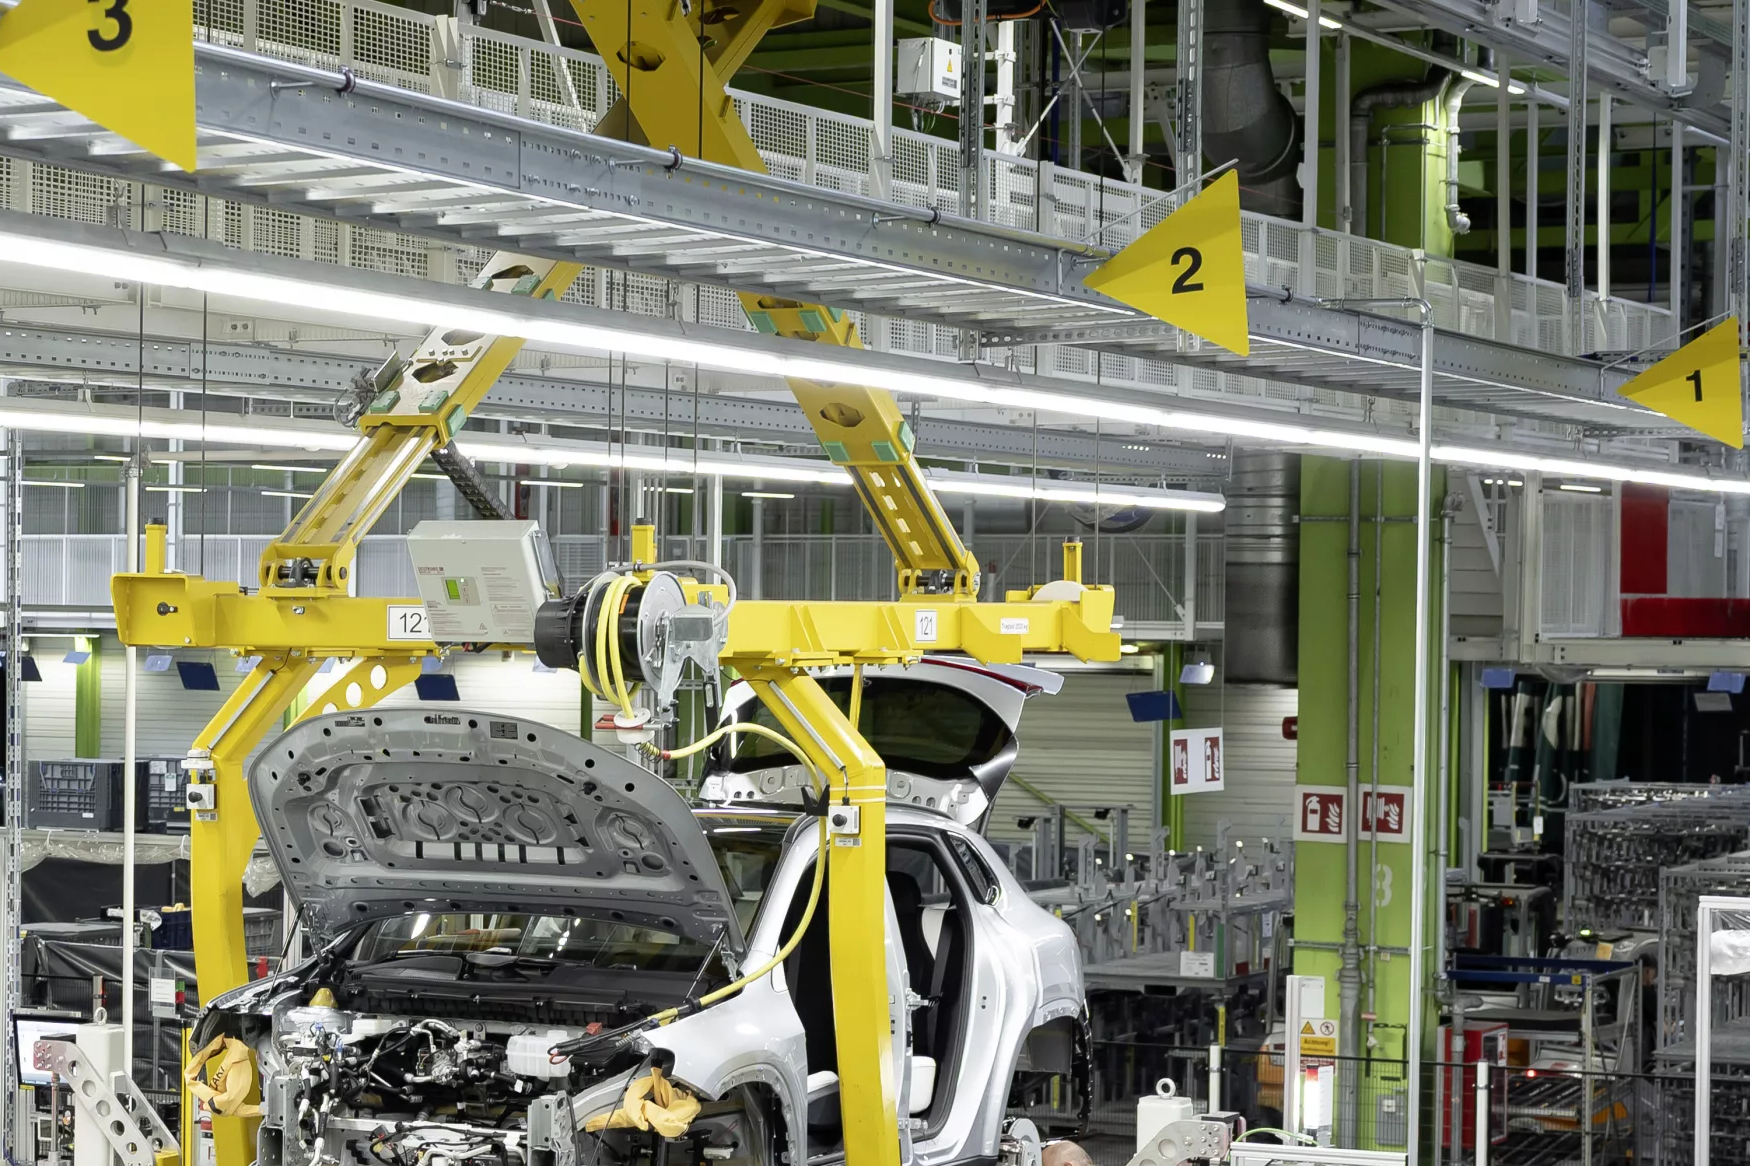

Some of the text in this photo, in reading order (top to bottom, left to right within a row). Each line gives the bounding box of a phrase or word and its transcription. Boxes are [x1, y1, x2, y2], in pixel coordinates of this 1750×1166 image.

[87, 0, 132, 52] 3
[1171, 246, 1204, 295] 2
[1686, 369, 1702, 402] 1
[919, 616, 933, 636] 121
